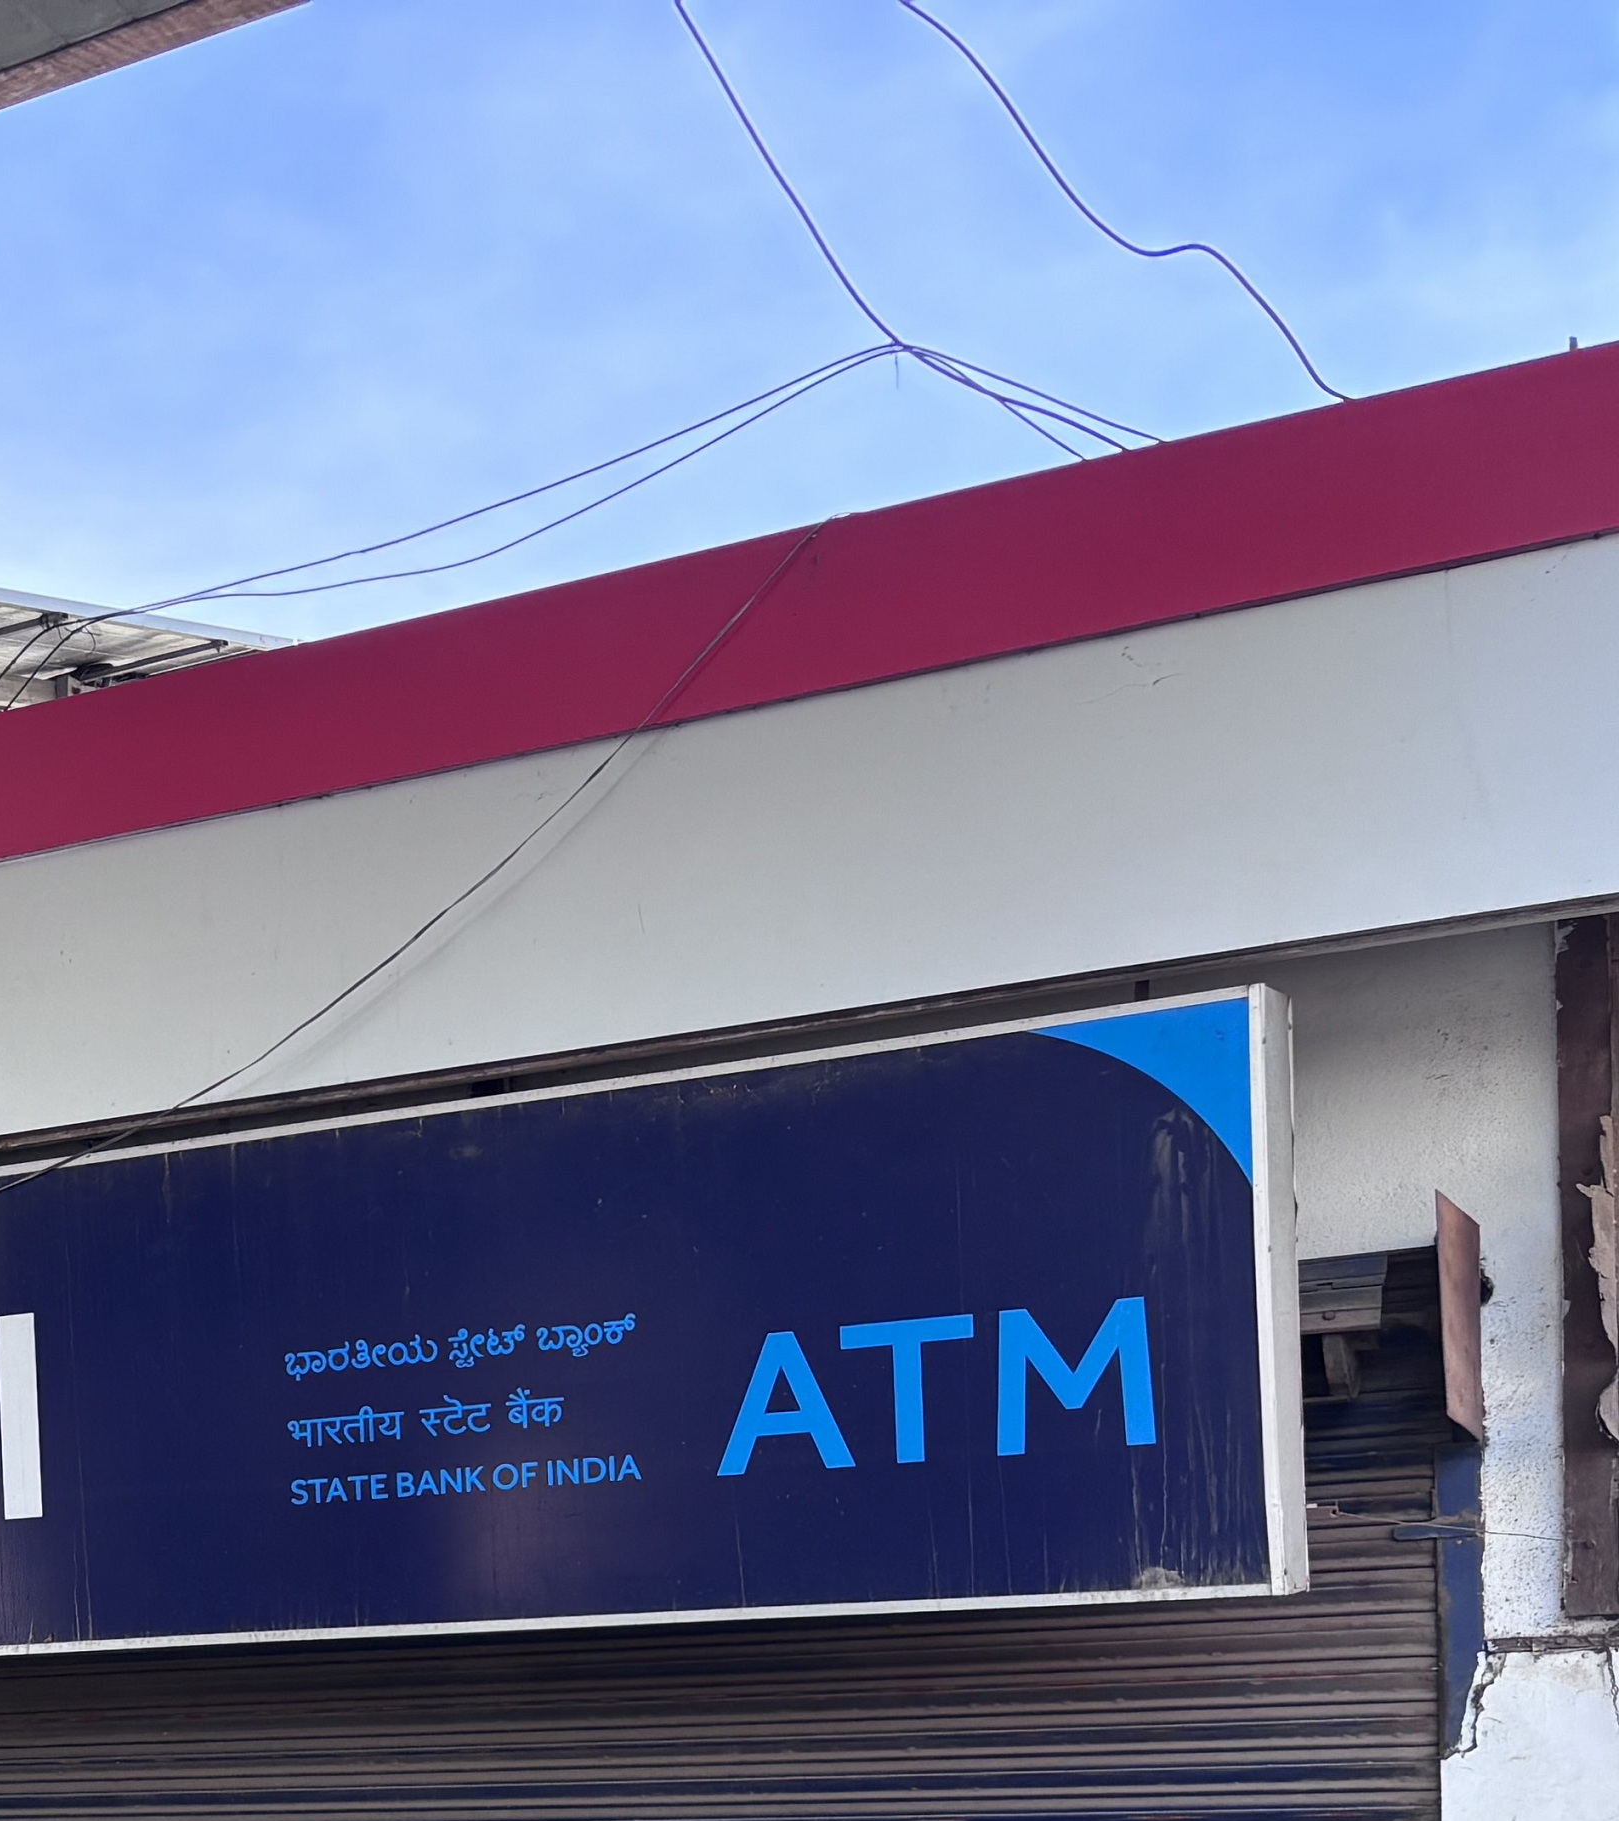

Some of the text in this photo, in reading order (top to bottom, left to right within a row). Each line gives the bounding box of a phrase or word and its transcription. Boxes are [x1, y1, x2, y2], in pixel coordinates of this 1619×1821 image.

[284, 1312, 636, 1381] ಭಾರತೀಯ ಸ್ಟೇಟ್ ಬ್ಯಾಂಕ್
[287, 1387, 564, 1447] भारतीय स्टेट बैंक
[717, 1294, 1159, 1478] ATM
[290, 1453, 642, 1506] STATE BANK OF INDIA
